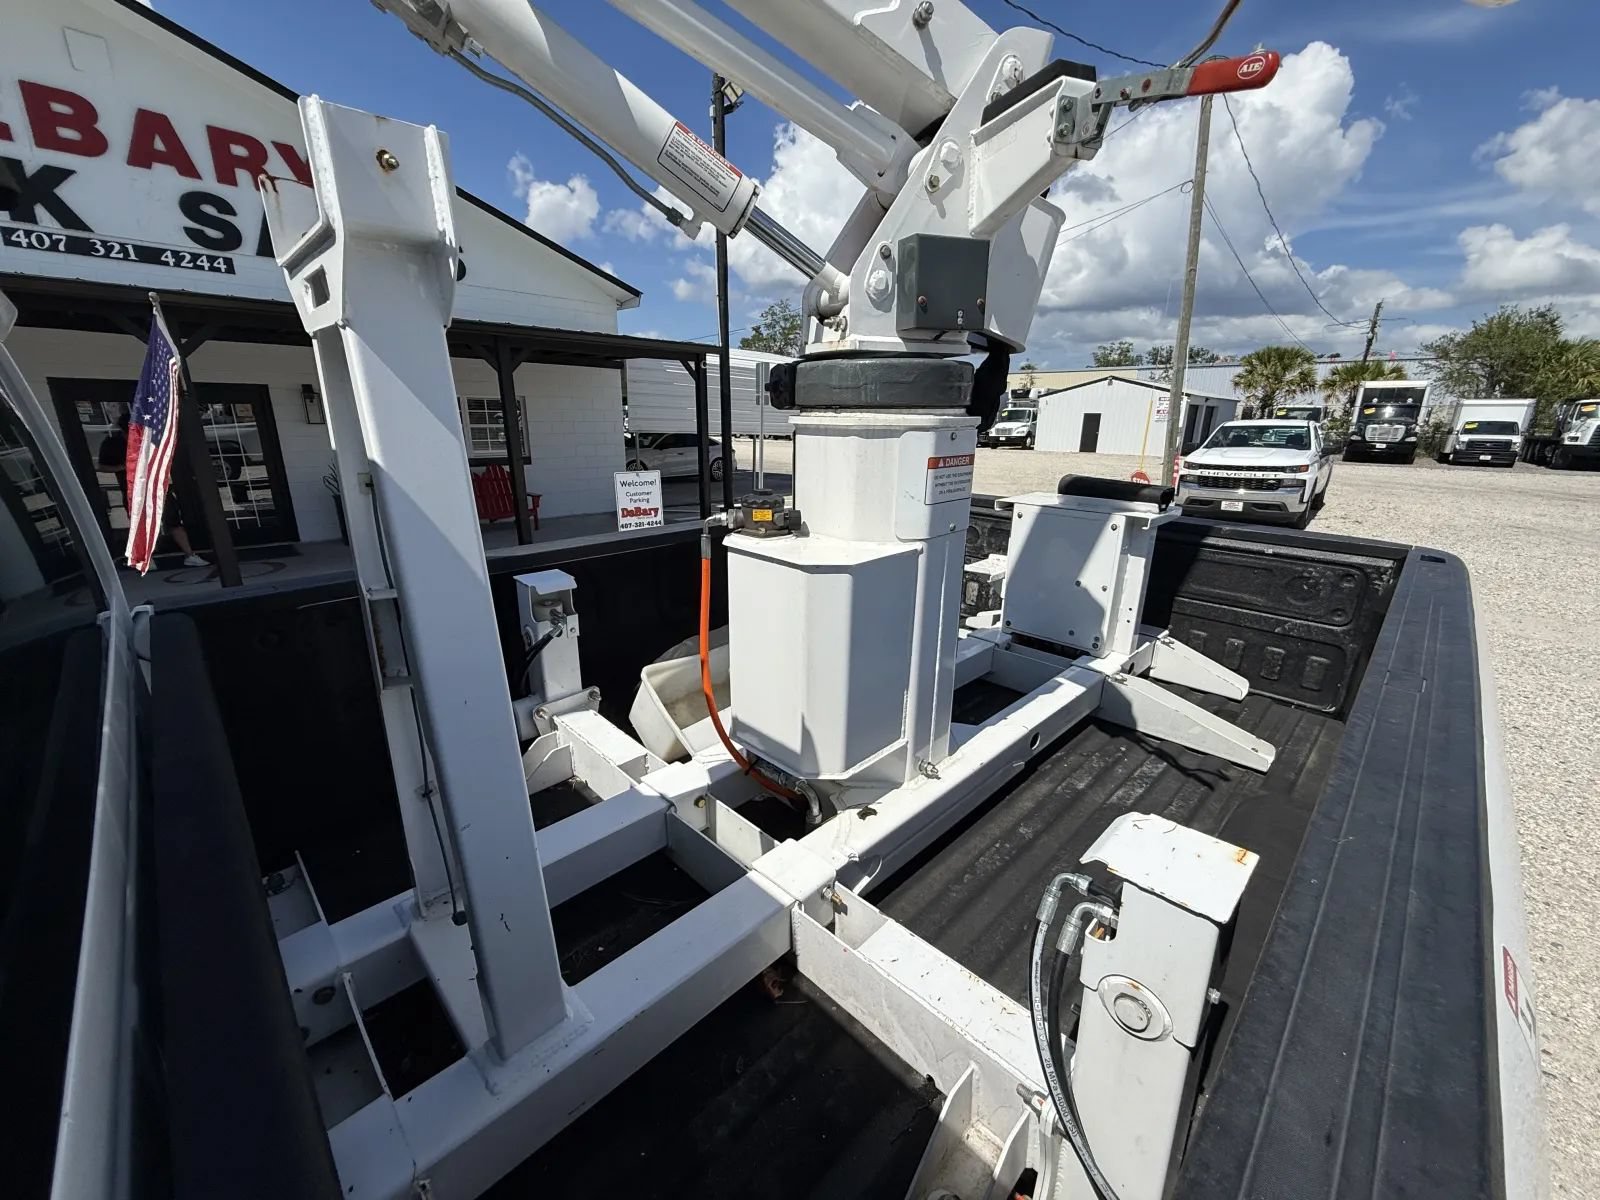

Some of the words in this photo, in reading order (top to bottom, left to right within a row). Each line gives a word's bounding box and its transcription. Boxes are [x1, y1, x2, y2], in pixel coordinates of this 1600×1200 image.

[1239, 62, 1262, 74] AIE
[11, 229, 67, 252] 407
[89, 238, 140, 261] 321
[160, 249, 228, 274] 4244
[945, 456, 970, 467] DANGER
[1200, 470, 1282, 478] CHEVROLET
[620, 479, 657, 487] Welcome!
[621, 506, 660, 518] DeBary
[620, 520, 662, 529] 407-321-4244
[1044, 1057, 1052, 1069] 28
[1048, 1070, 1059, 1091] MPa
[1065, 1118, 1079, 1138] PSI)
